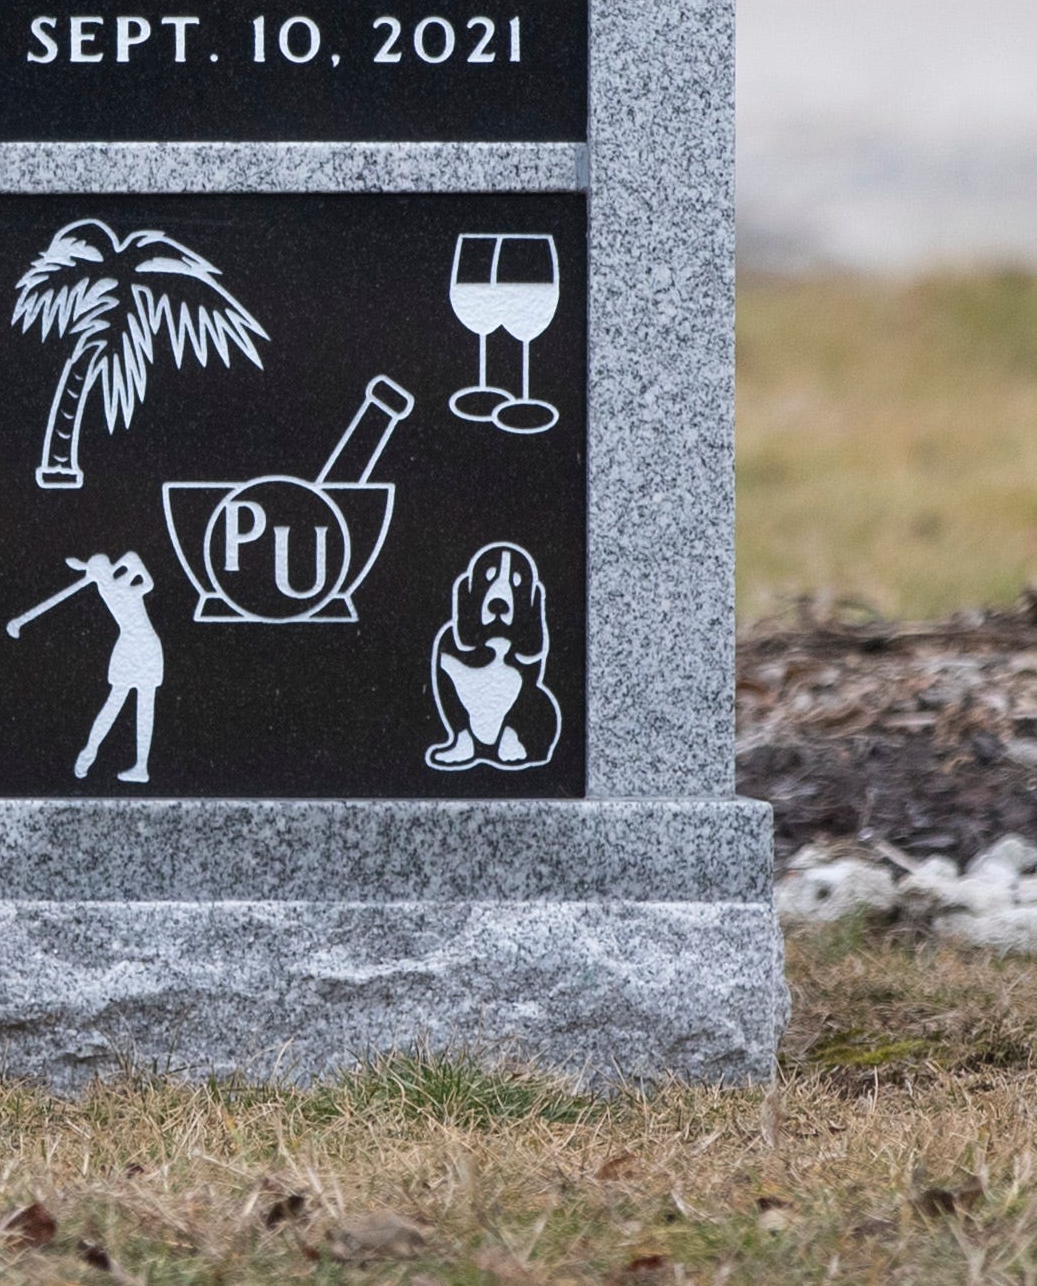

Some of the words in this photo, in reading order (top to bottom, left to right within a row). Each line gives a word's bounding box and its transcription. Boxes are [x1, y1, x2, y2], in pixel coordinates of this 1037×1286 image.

[26, 15, 219, 64] SEPT.
[252, 15, 341, 68] 10,
[372, 15, 521, 64] 2021
